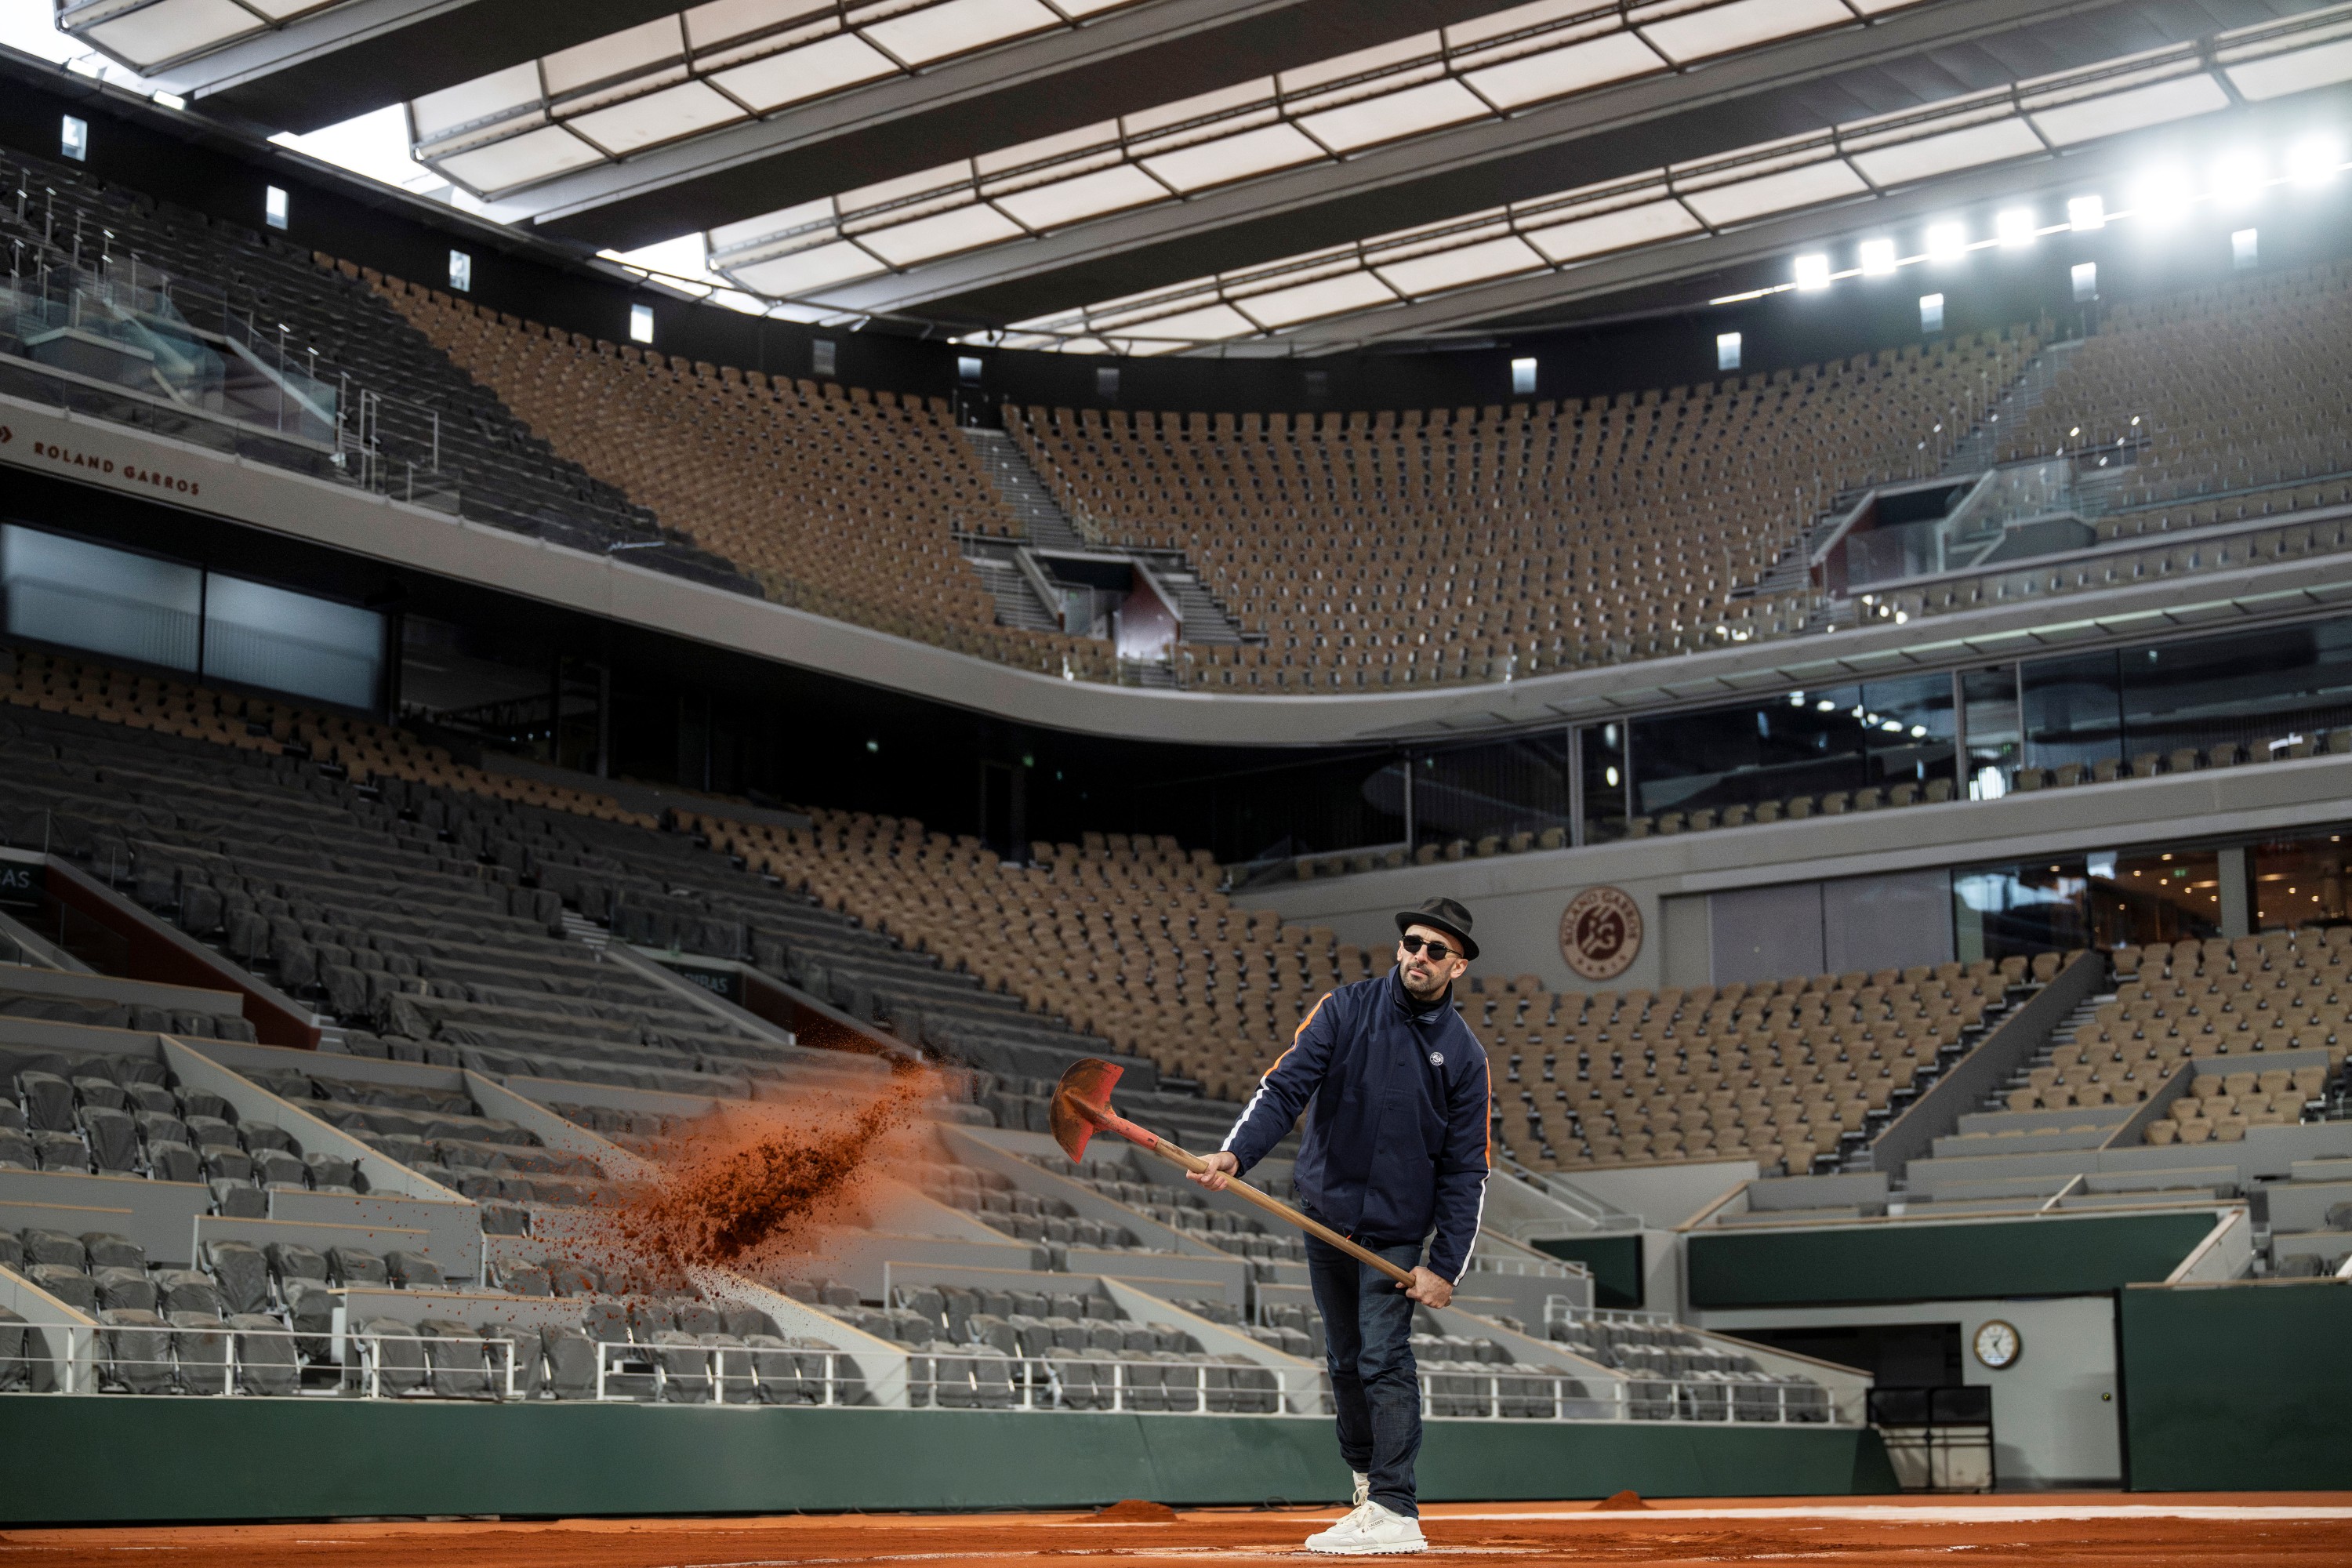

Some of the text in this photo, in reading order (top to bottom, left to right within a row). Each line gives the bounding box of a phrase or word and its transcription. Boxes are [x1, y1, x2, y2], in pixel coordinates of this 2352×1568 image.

[34, 441, 200, 495] ROLAND GARROS
[0, 869, 31, 888] AS
